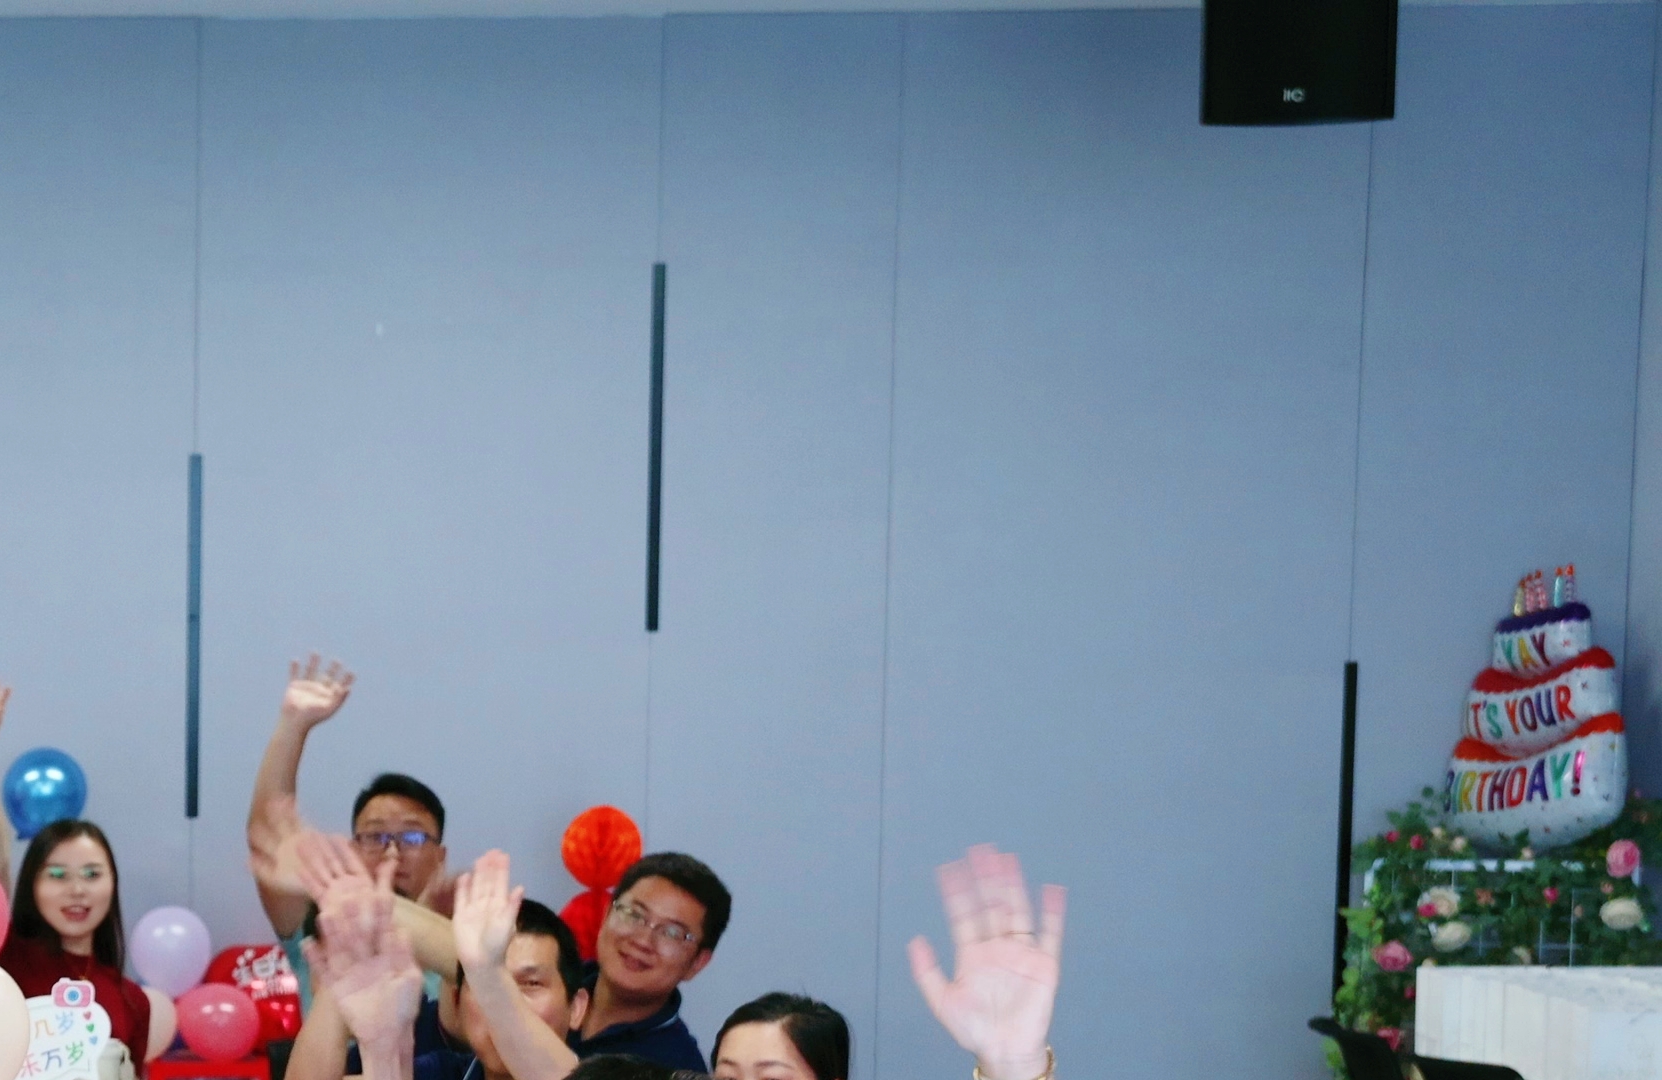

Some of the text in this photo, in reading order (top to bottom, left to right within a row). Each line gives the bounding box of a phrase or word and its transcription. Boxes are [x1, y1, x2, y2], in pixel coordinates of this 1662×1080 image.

[1500, 632, 1551, 672] YAY
[1504, 684, 1576, 736] YOUR
[1443, 751, 1586, 814] BIRTHDAY!
